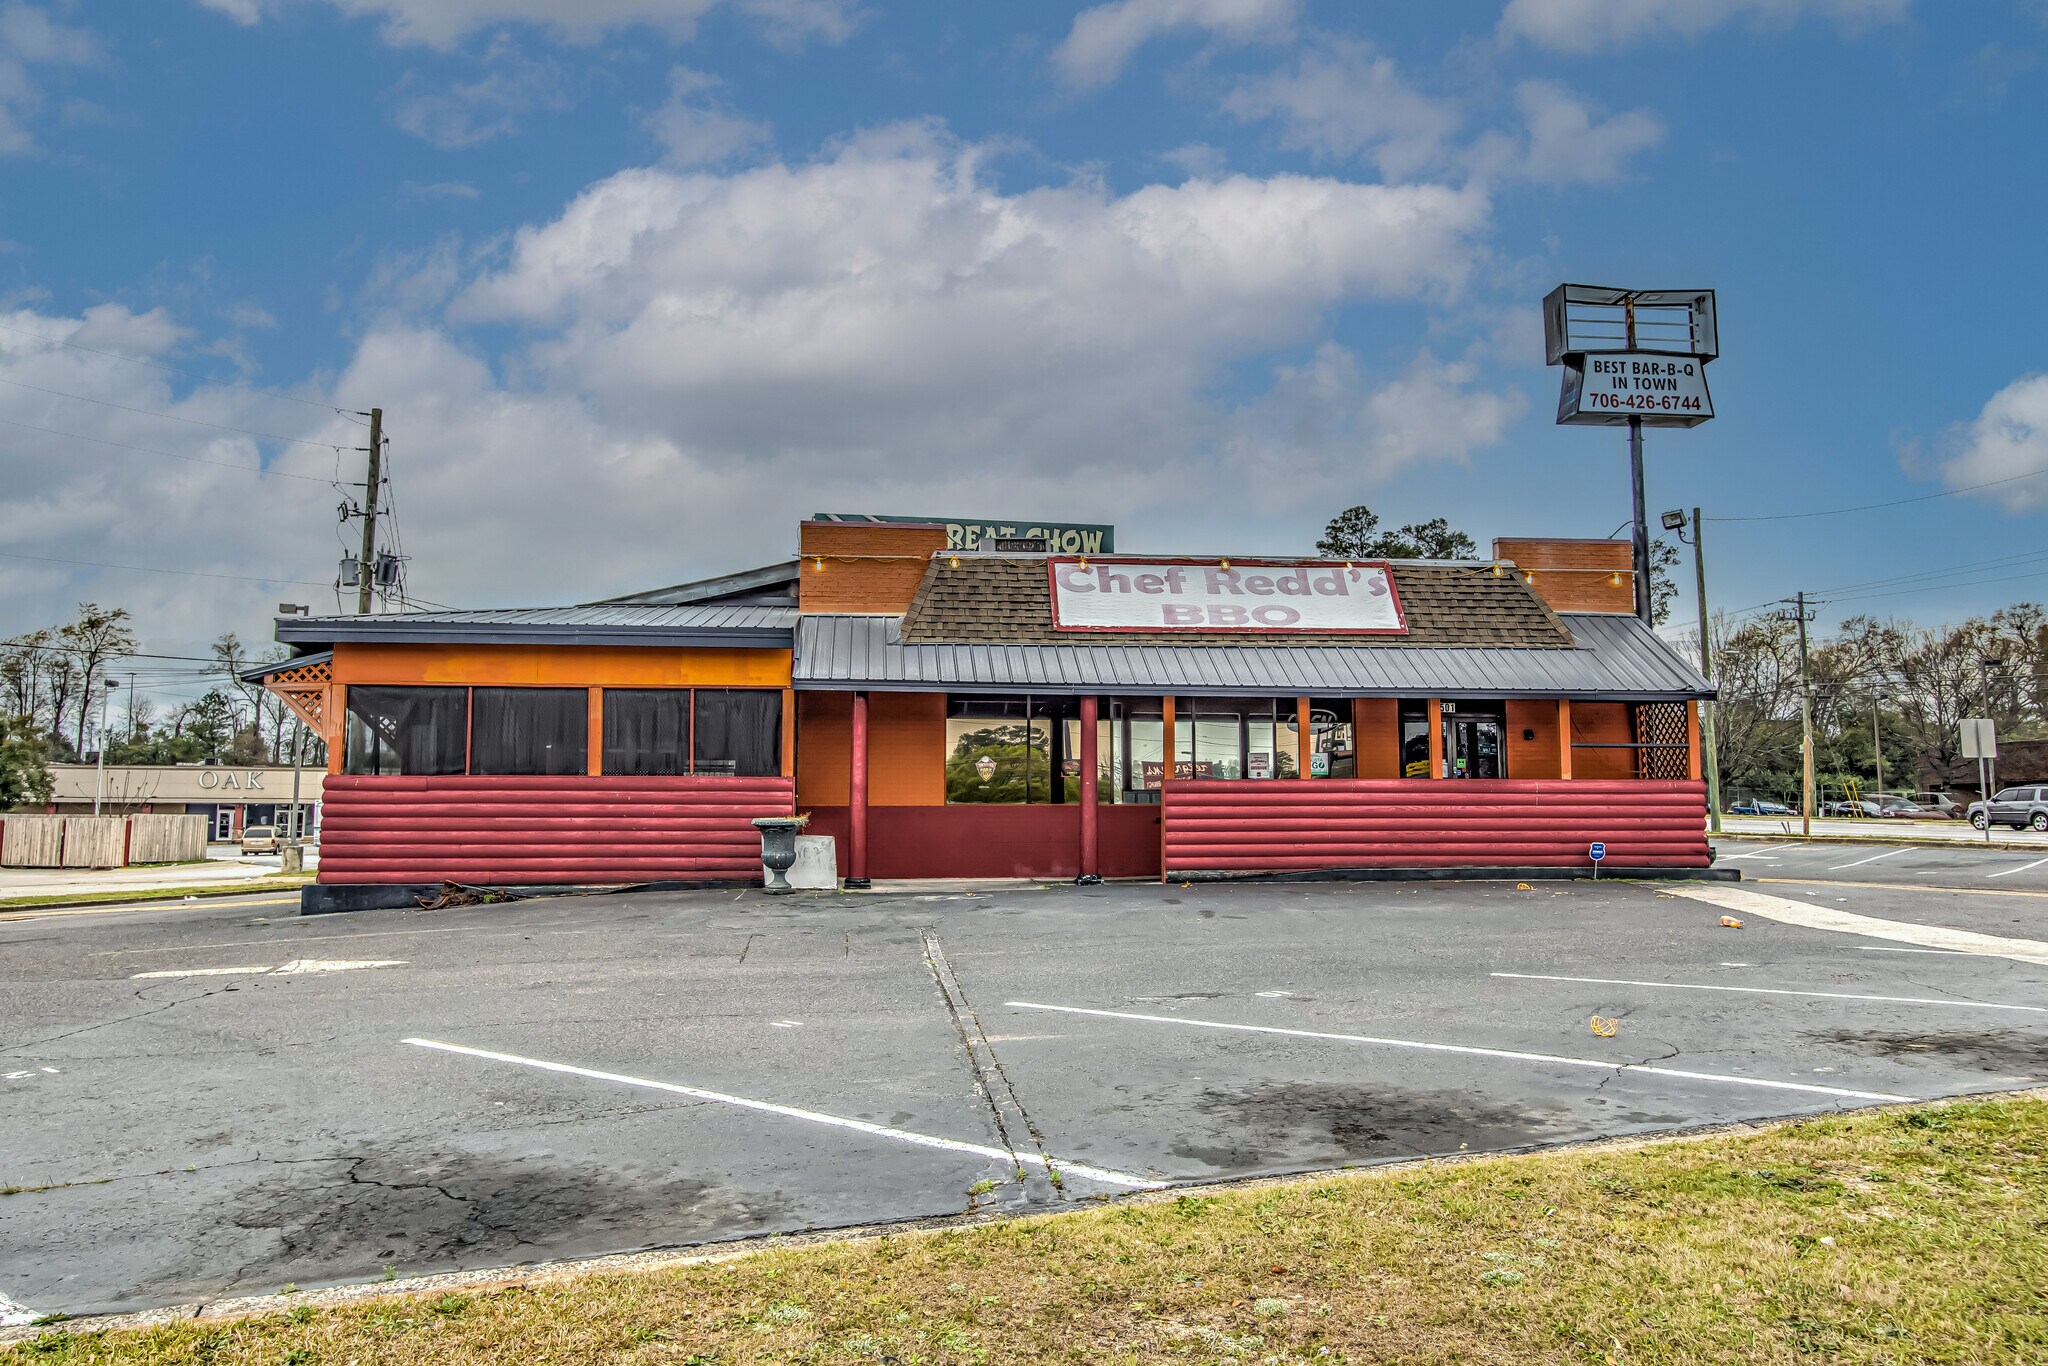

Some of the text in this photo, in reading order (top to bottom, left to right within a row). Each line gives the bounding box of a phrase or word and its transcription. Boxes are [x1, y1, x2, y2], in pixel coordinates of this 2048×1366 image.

[1594, 360, 1694, 377] BEST BAR-B-Q
[1612, 376, 1677, 391] IN TOWN
[1590, 393, 1701, 411] 706-426-6744
[946, 523, 1016, 552] REAT
[1056, 565, 1388, 598] Chef Redd's
[198, 770, 265, 789] OAK
